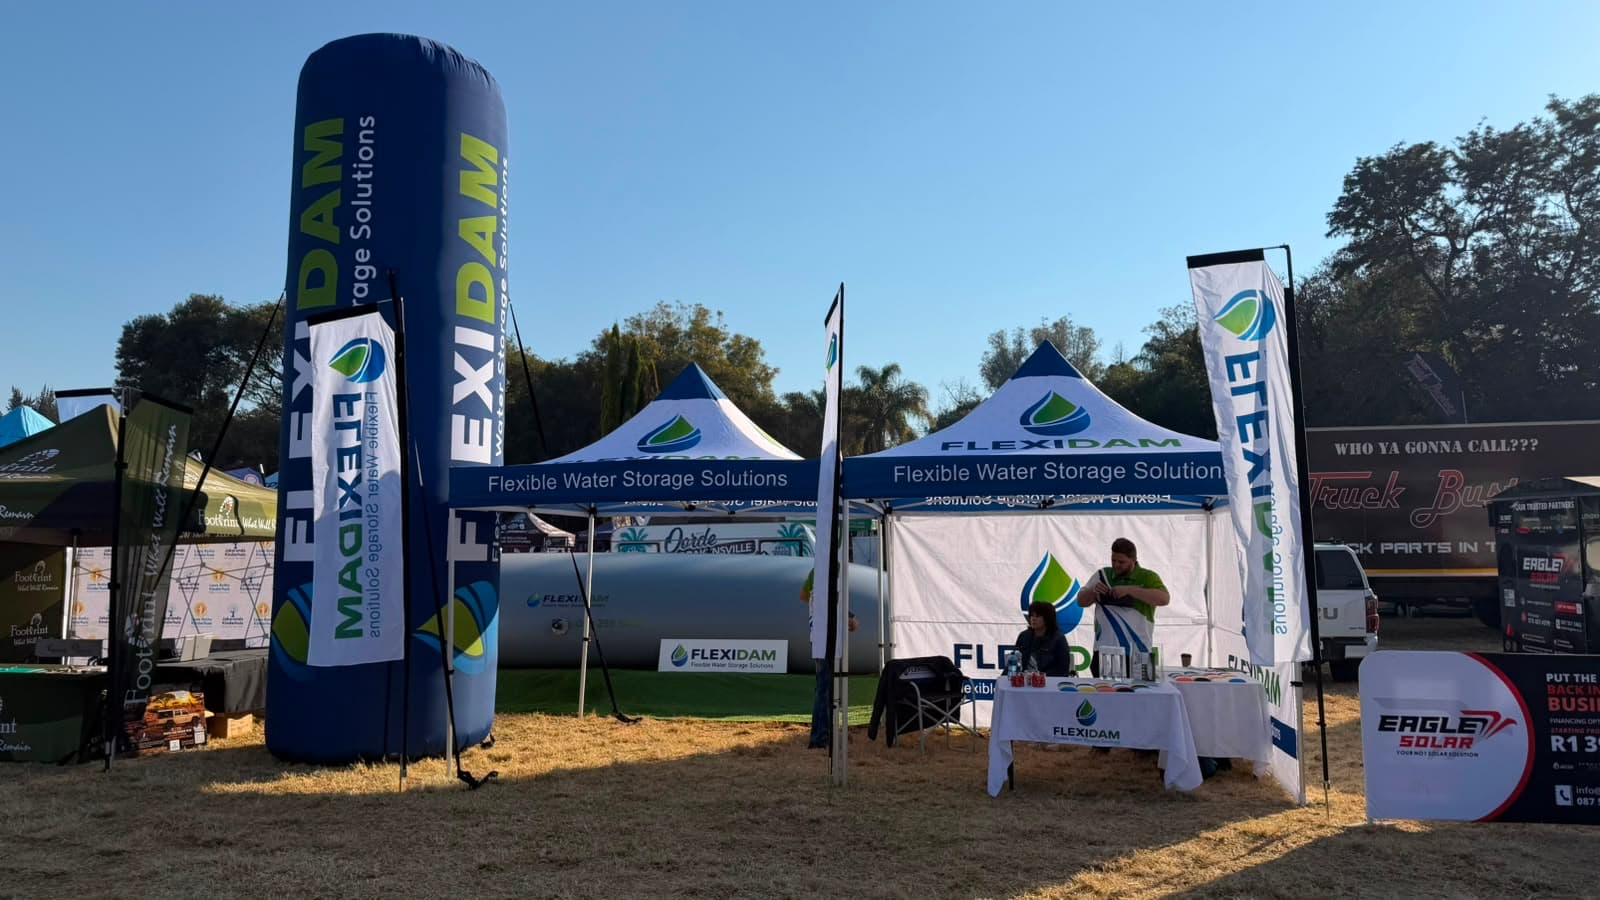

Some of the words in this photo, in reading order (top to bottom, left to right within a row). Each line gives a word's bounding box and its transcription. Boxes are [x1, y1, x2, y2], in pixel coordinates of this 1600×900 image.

[351, 116, 375, 239] Solutions
[499, 157, 508, 271] Solutions
[496, 278, 508, 375] Storage
[446, 132, 498, 561] FEXIDAM
[495, 382, 504, 457] Water
[941, 438, 1183, 451] FLEXIDAM
[1334, 442, 1373, 455] WHO
[1379, 442, 1400, 455] YA
[1405, 440, 1462, 454] GONNA
[1468, 438, 1539, 452] CALL???
[488, 474, 557, 492] Flexible
[563, 472, 617, 489] Water
[622, 470, 694, 490] Storage
[700, 469, 788, 487] Solutions
[894, 465, 970, 483] Flexible
[977, 464, 1037, 481] Water
[1044, 462, 1126, 484] Storage
[1134, 461, 1223, 480] Solution
[1308, 470, 1405, 510] Truck
[1380, 541, 1452, 554] PARTS
[1459, 541, 1478, 553] IN
[1523, 557, 1561, 572] EAGLE
[691, 648, 777, 661] FLEXIDAM
[1545, 672, 1570, 683] PUT
[1572, 673, 1597, 683] THE
[1547, 684, 1584, 695] BACK
[1378, 714, 1478, 734] EAGLE
[1549, 717, 1587, 725] FINANCING
[1053, 726, 1121, 740] FLEXIDAM
[1399, 735, 1474, 750] SOLAR
[1551, 735, 1578, 753] R1
[1576, 797, 1595, 806] 087
